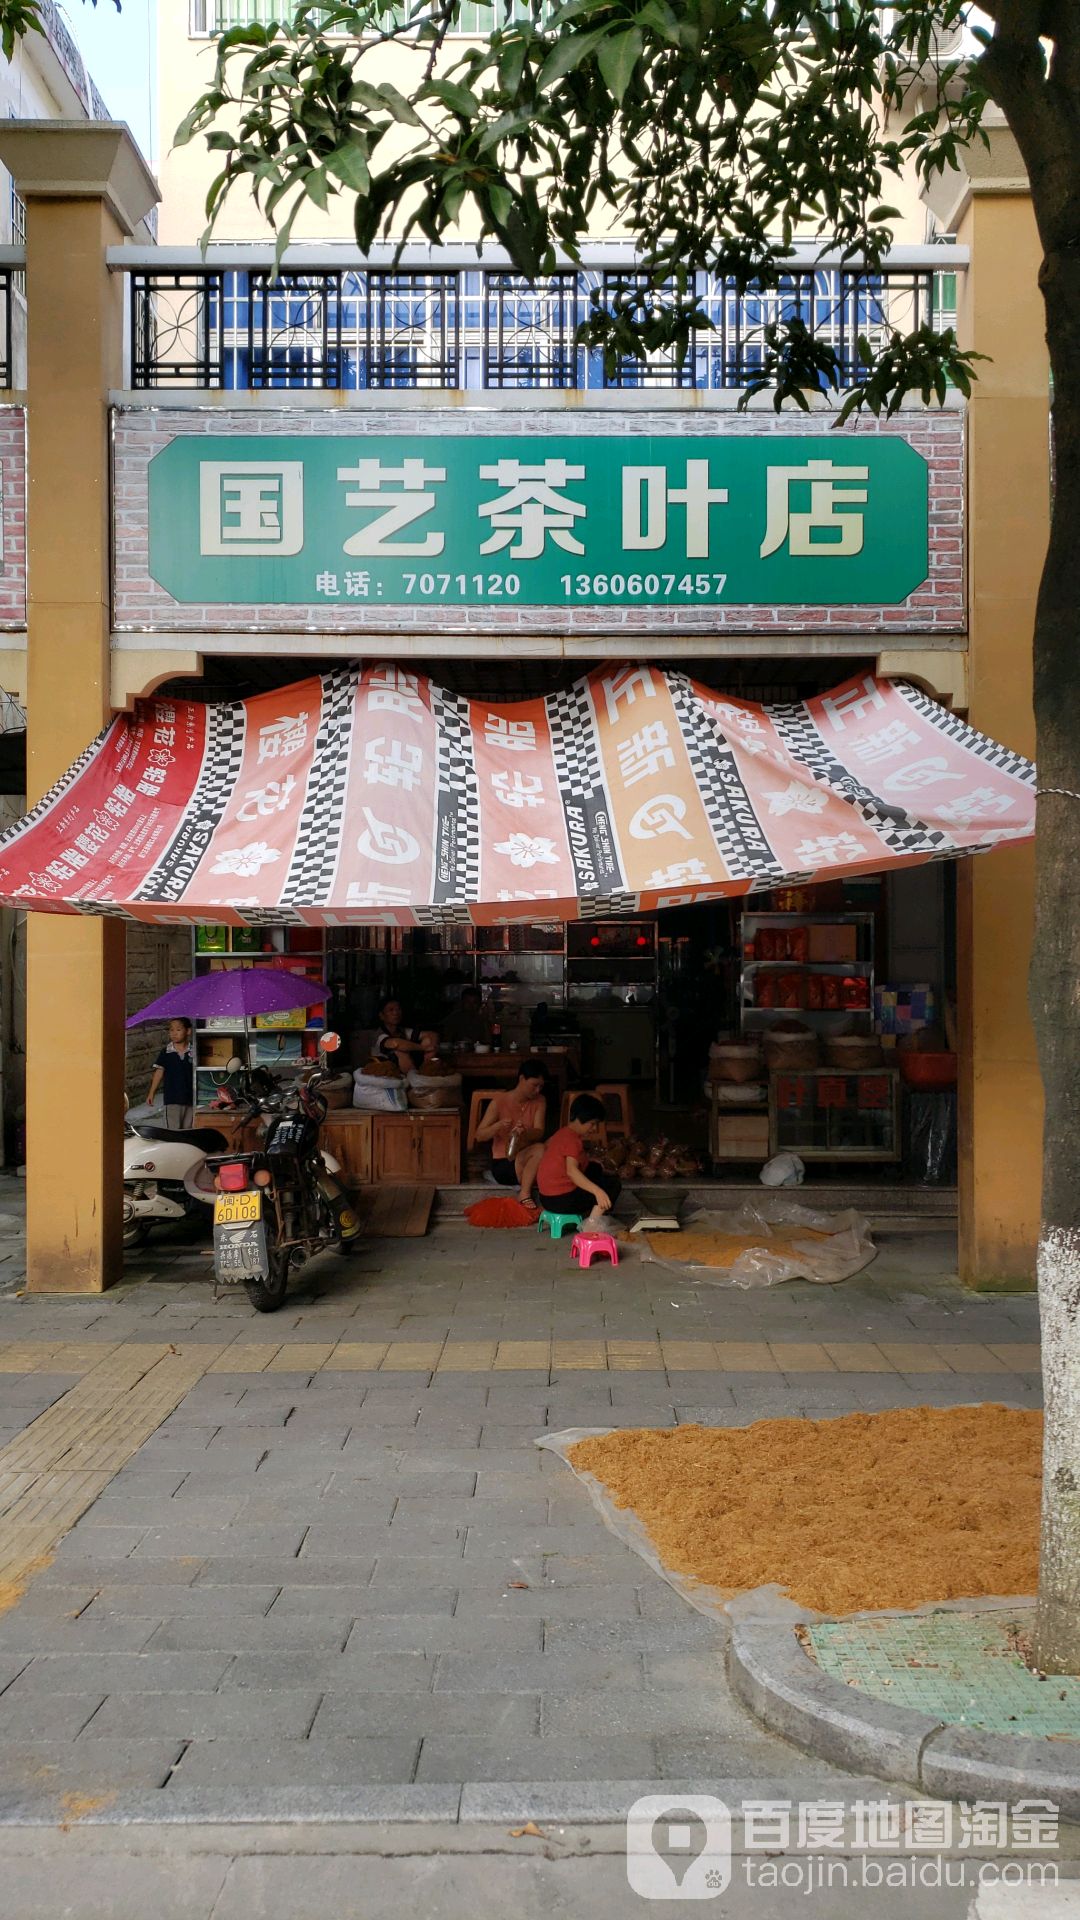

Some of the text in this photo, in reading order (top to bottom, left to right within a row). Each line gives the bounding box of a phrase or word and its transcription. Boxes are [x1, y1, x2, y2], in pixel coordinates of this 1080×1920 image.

[199, 457, 870, 559] 国艺茶叶店
[402, 573, 521, 595] 7071120
[560, 574, 727, 596] 1360607457
[601, 665, 677, 789] 正新
[821, 676, 922, 766] 正新
[484, 712, 545, 808] 轮胎
[104, 783, 137, 818] 轮胎
[135, 766, 167, 797] 轮胎
[719, 771, 768, 854] SAKURA
[166, 825, 194, 867] SAKURA
[566, 805, 596, 881] SAKURA
[601, 836, 611, 854] SHIN
[45, 848, 90, 881] 轮胎
[160, 831, 209, 901] SAKURA
[604, 855, 614, 874] TIRE
[219, 1241, 259, 1250] HONDA
